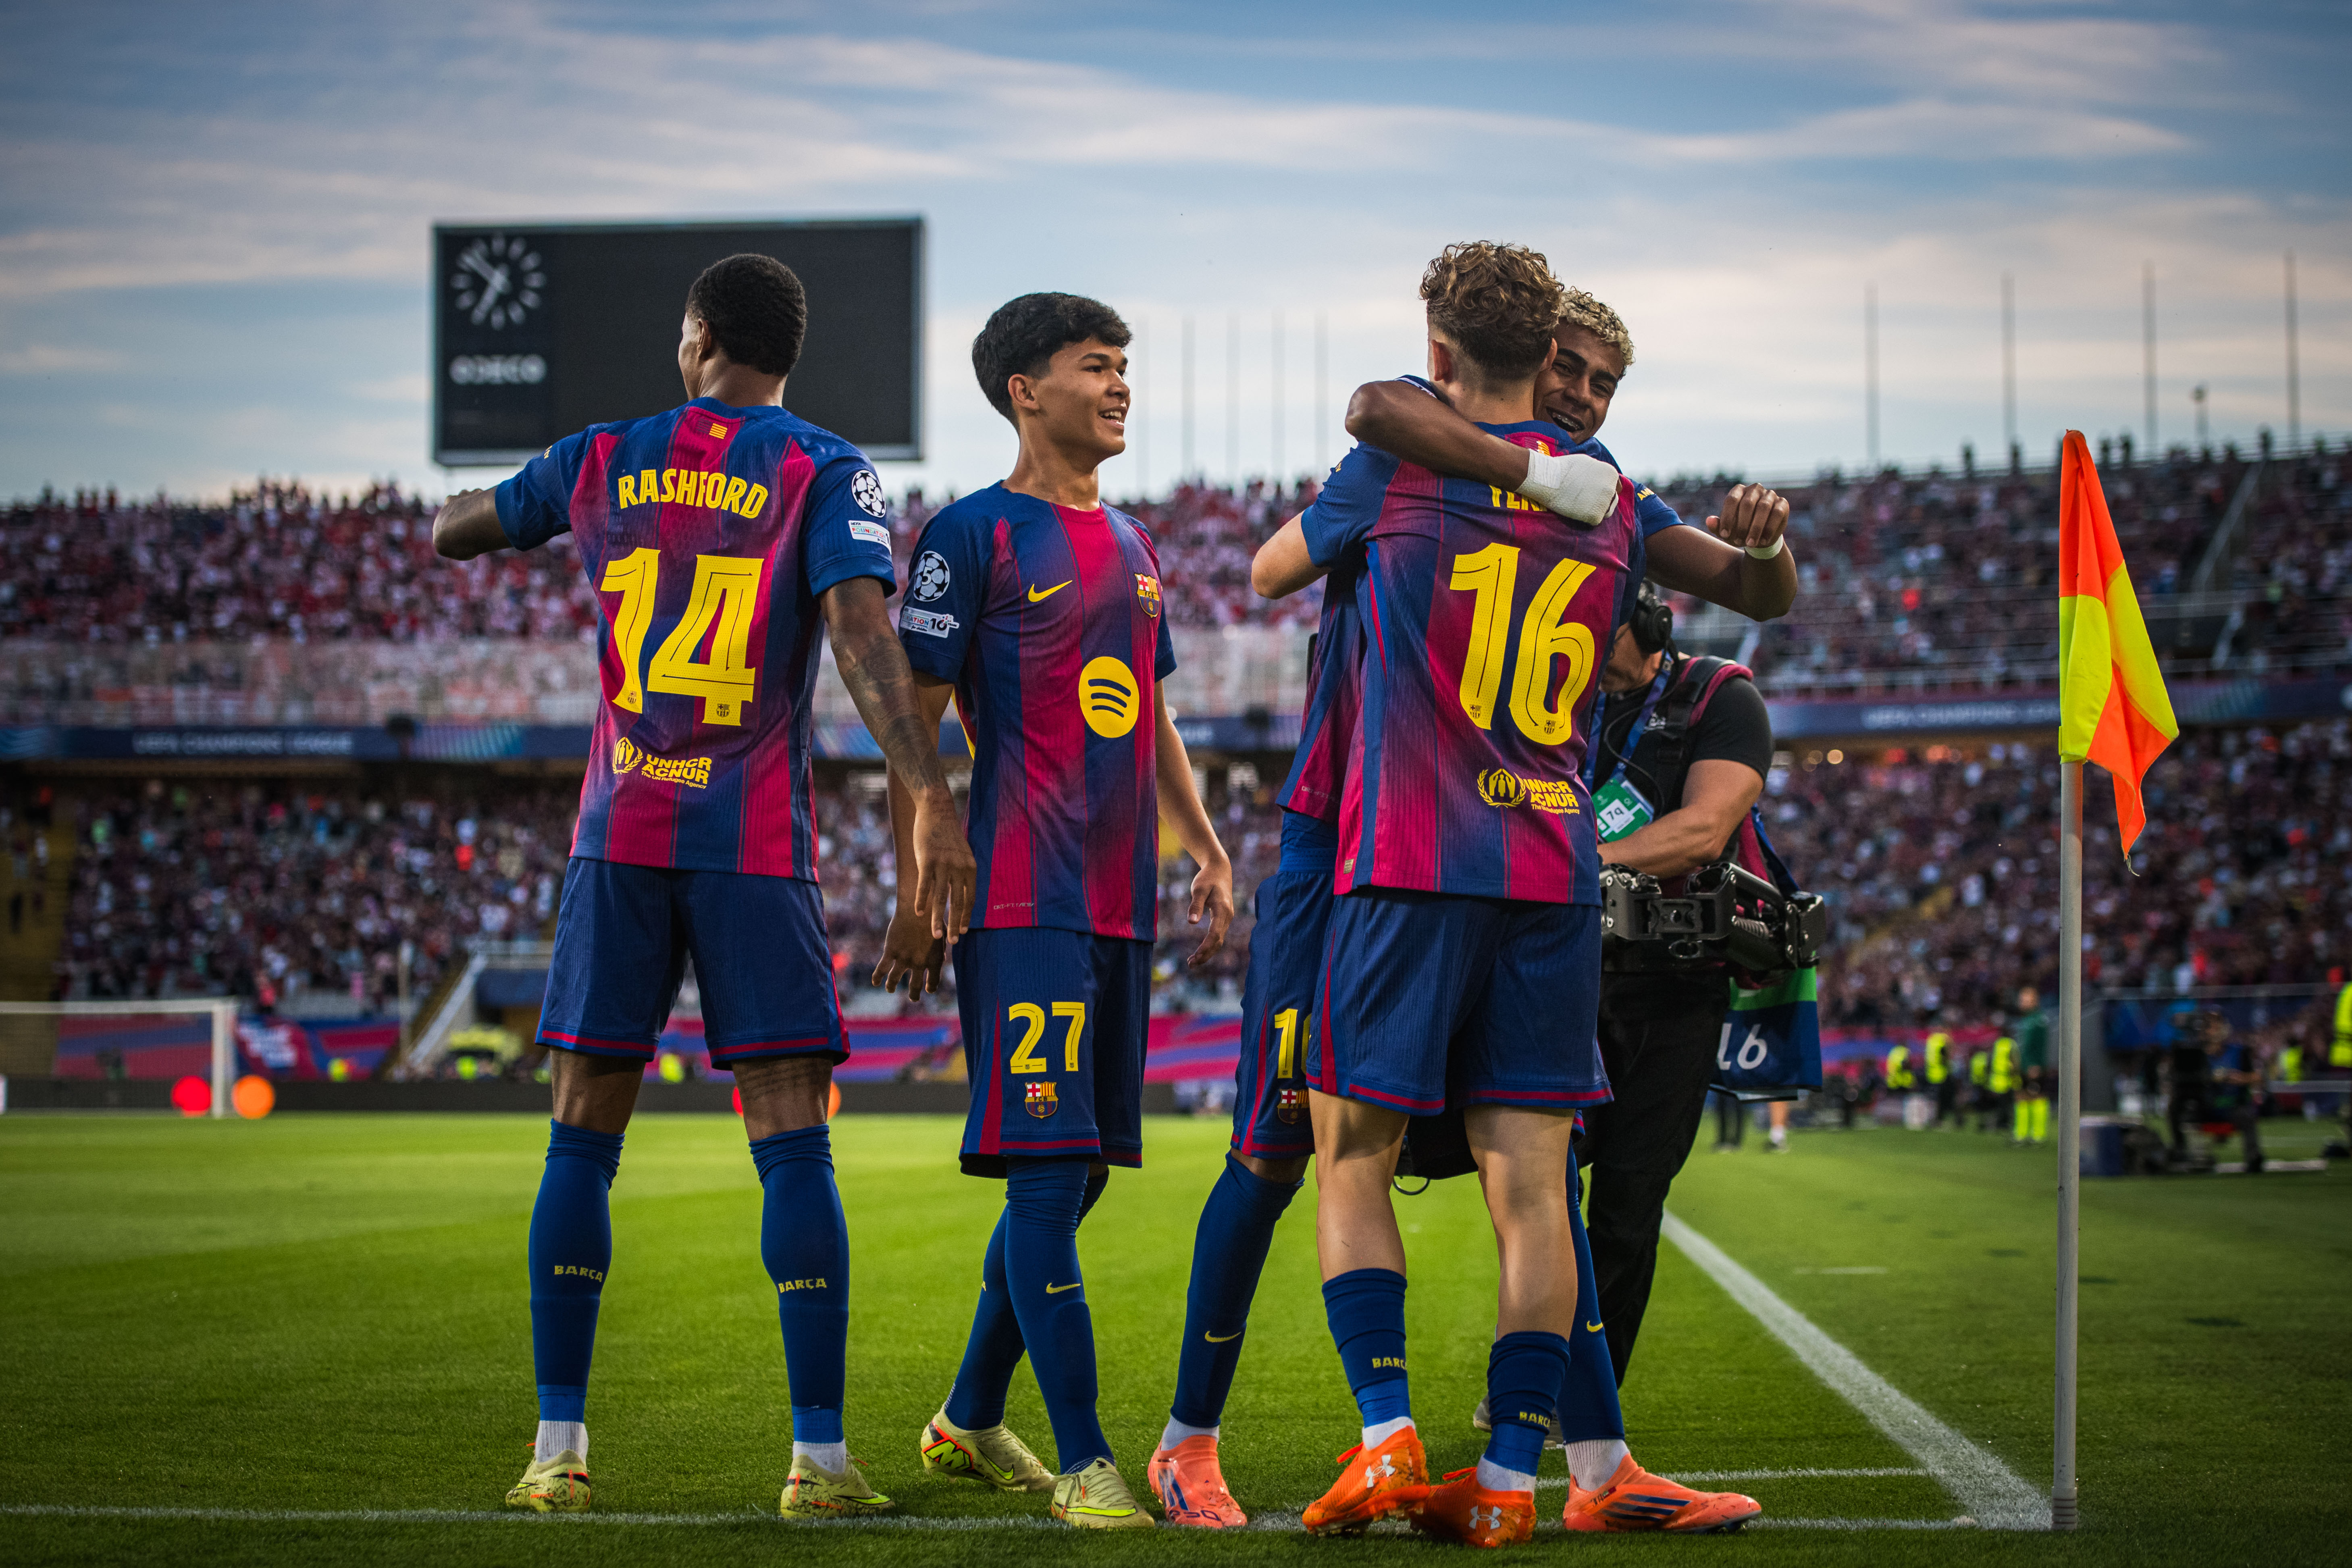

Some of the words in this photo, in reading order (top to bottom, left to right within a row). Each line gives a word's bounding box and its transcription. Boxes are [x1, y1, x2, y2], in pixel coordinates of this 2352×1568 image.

[618, 469, 768, 519] RASHFORD
[867, 485, 877, 503] 5
[921, 566, 932, 585] 5
[930, 618, 948, 631] 10
[600, 547, 765, 726] 14
[1449, 542, 1597, 745] 16
[646, 754, 712, 771] UNHCR
[641, 763, 709, 784] ACNUR
[685, 780, 707, 789] Agency
[1531, 790, 1579, 807] ACNUR
[1009, 1002, 1086, 1074] 27
[554, 1265, 603, 1283] BARÇA
[778, 1278, 827, 1293] BARÇA
